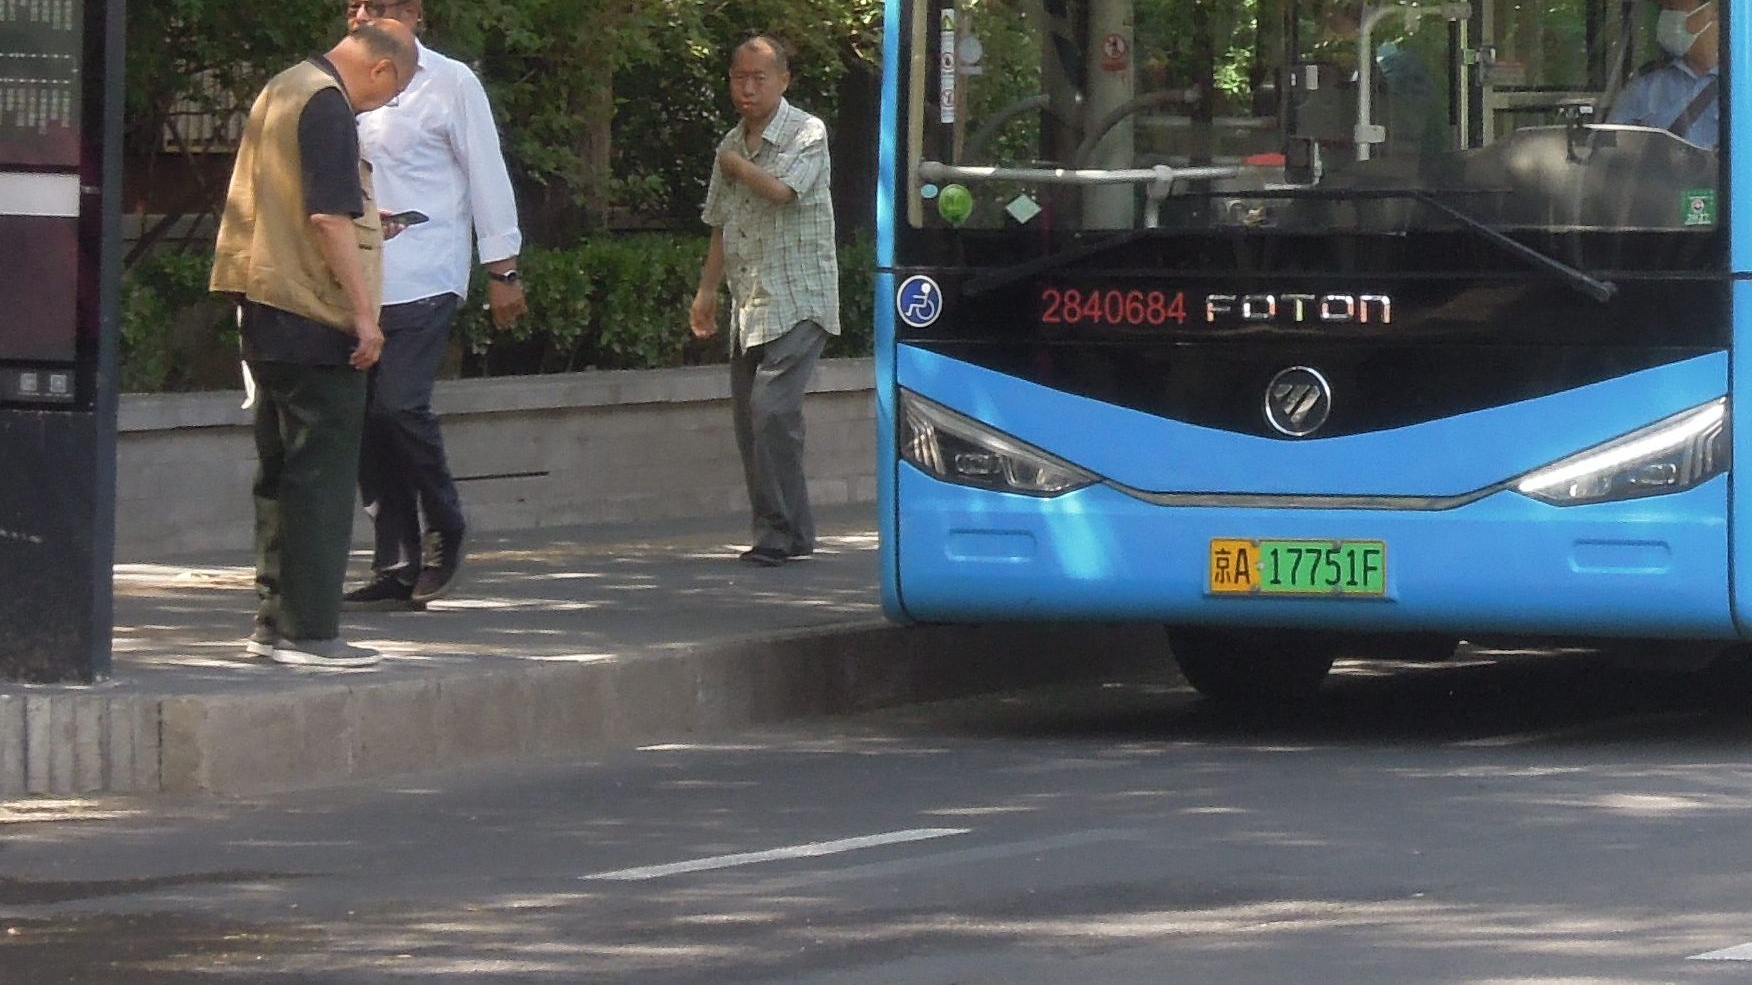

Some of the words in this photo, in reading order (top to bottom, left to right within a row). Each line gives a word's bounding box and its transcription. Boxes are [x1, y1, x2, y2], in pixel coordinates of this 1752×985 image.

[1042, 289, 1186, 324] 2840684
[1206, 294, 1391, 323] FOTON
[1269, 548, 1380, 586] 17751F
